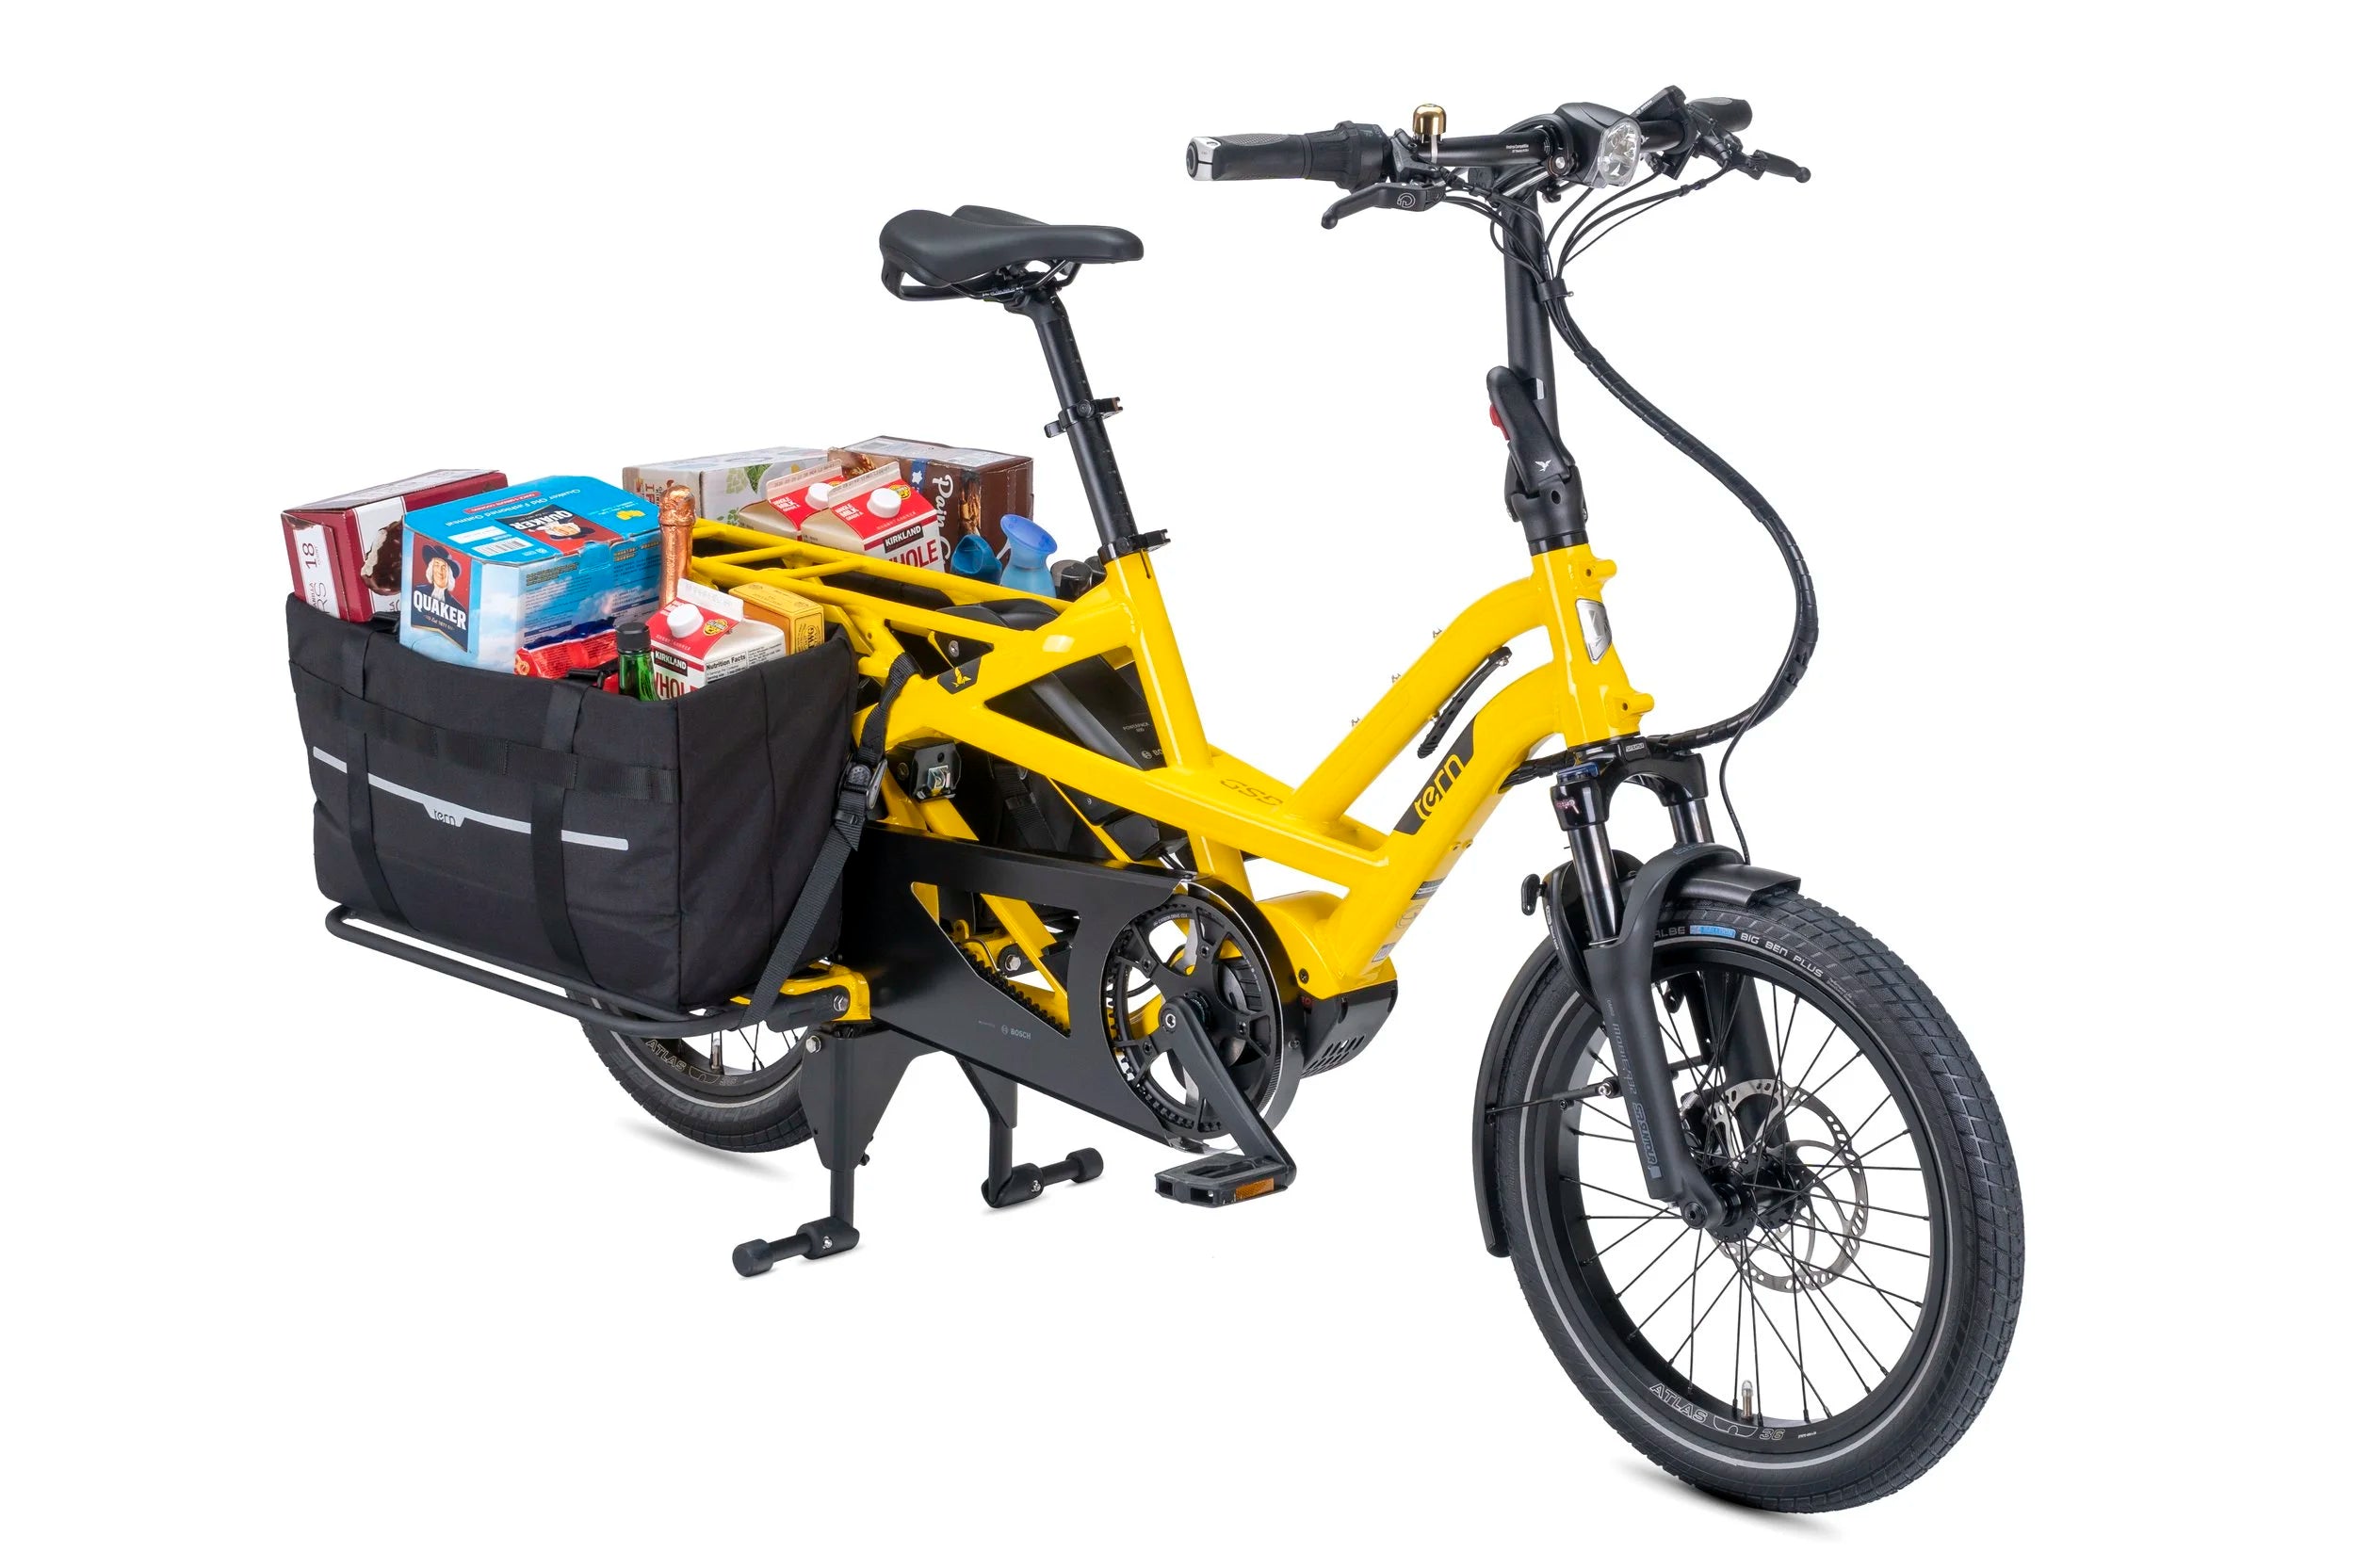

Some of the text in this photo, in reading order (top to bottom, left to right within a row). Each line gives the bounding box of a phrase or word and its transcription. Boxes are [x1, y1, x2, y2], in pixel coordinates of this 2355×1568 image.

[932, 474, 953, 528] Pain
[512, 509, 574, 531] QUAKER
[885, 525, 921, 547] KIRKLAND
[301, 542, 318, 570] 18
[413, 590, 467, 631] QUAKER
[655, 650, 687, 671] KIRKLAND
[706, 659, 731, 671] Nutrition
[730, 655, 746, 664] Facts
[1414, 753, 1464, 820] tern
[433, 809, 456, 827] tern
[1740, 932, 1760, 945] BIG
[1793, 954, 1825, 978] PLUS
[1010, 1027, 1031, 1041] BOSCH
[645, 1039, 687, 1072] ATLAS
[1648, 1382, 1785, 1441] ATLAS 36
